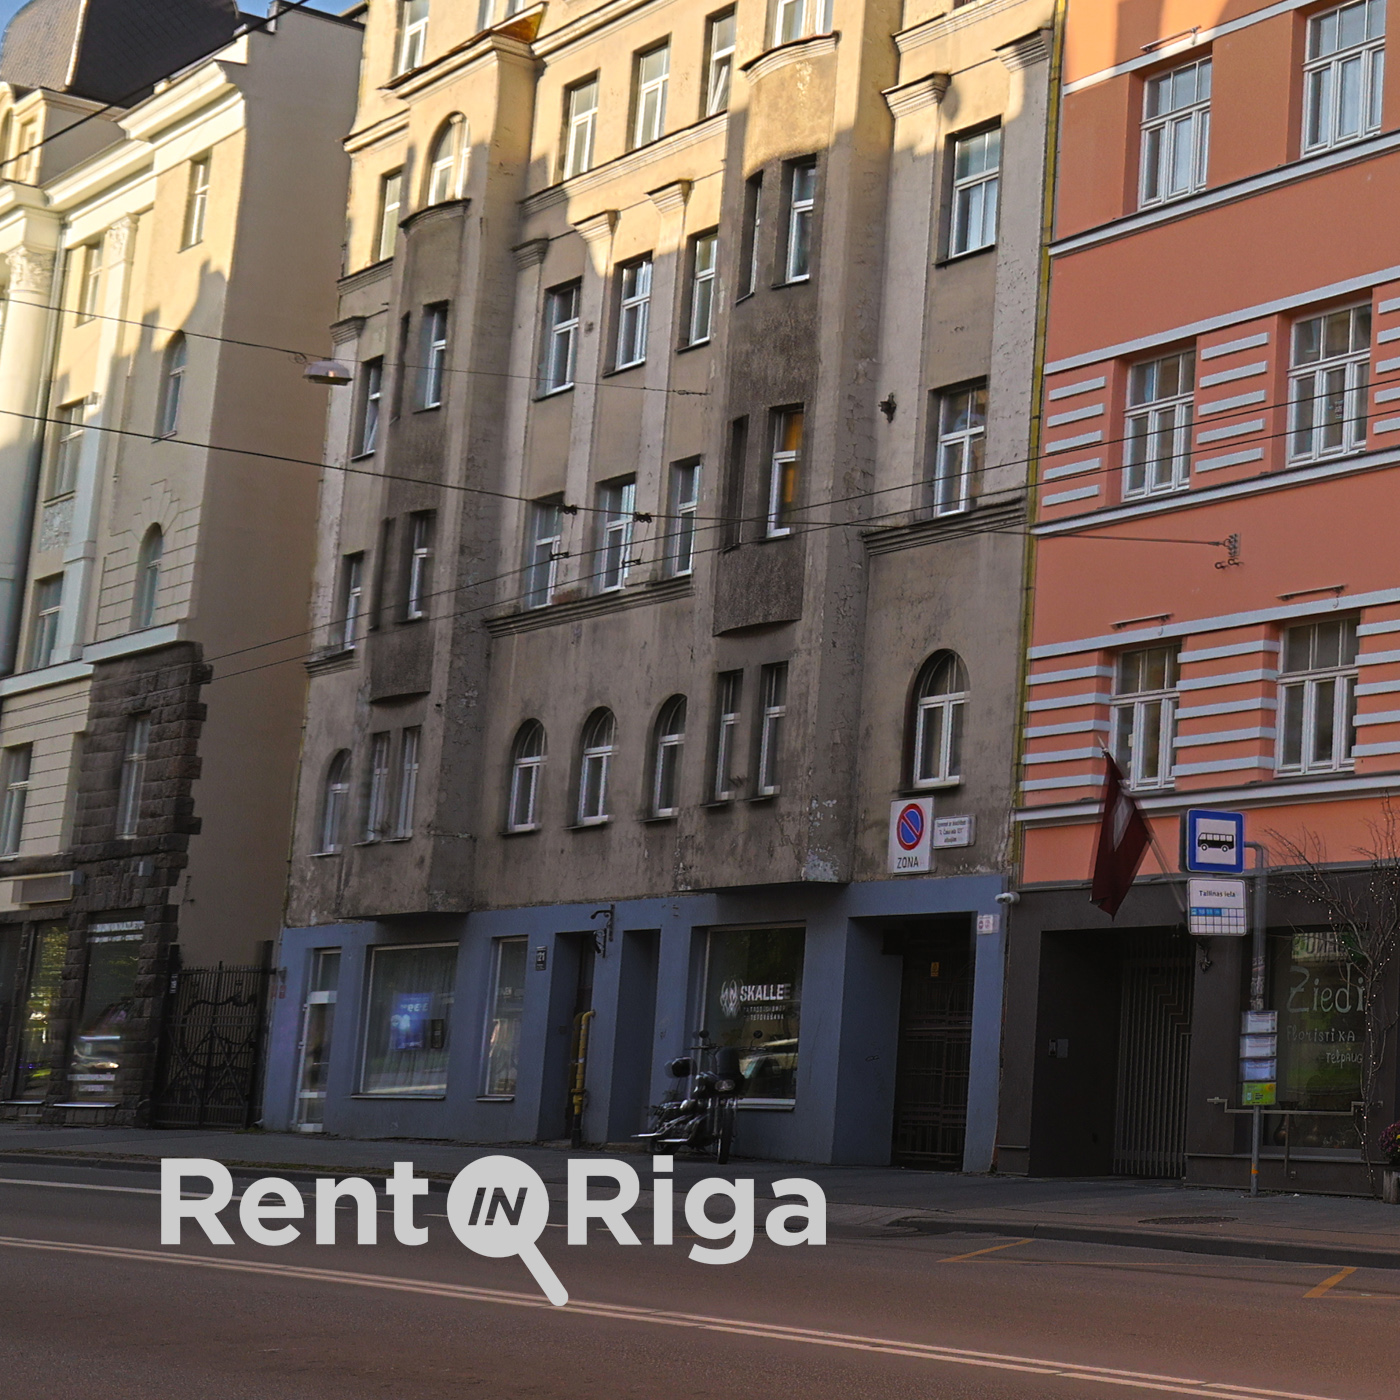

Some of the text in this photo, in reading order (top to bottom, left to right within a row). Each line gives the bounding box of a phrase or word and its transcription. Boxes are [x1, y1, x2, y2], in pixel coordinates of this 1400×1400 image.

[897, 856, 919, 869] ZONA
[1224, 890, 1236, 898] iela
[1286, 962, 1366, 1014] Ziedi
